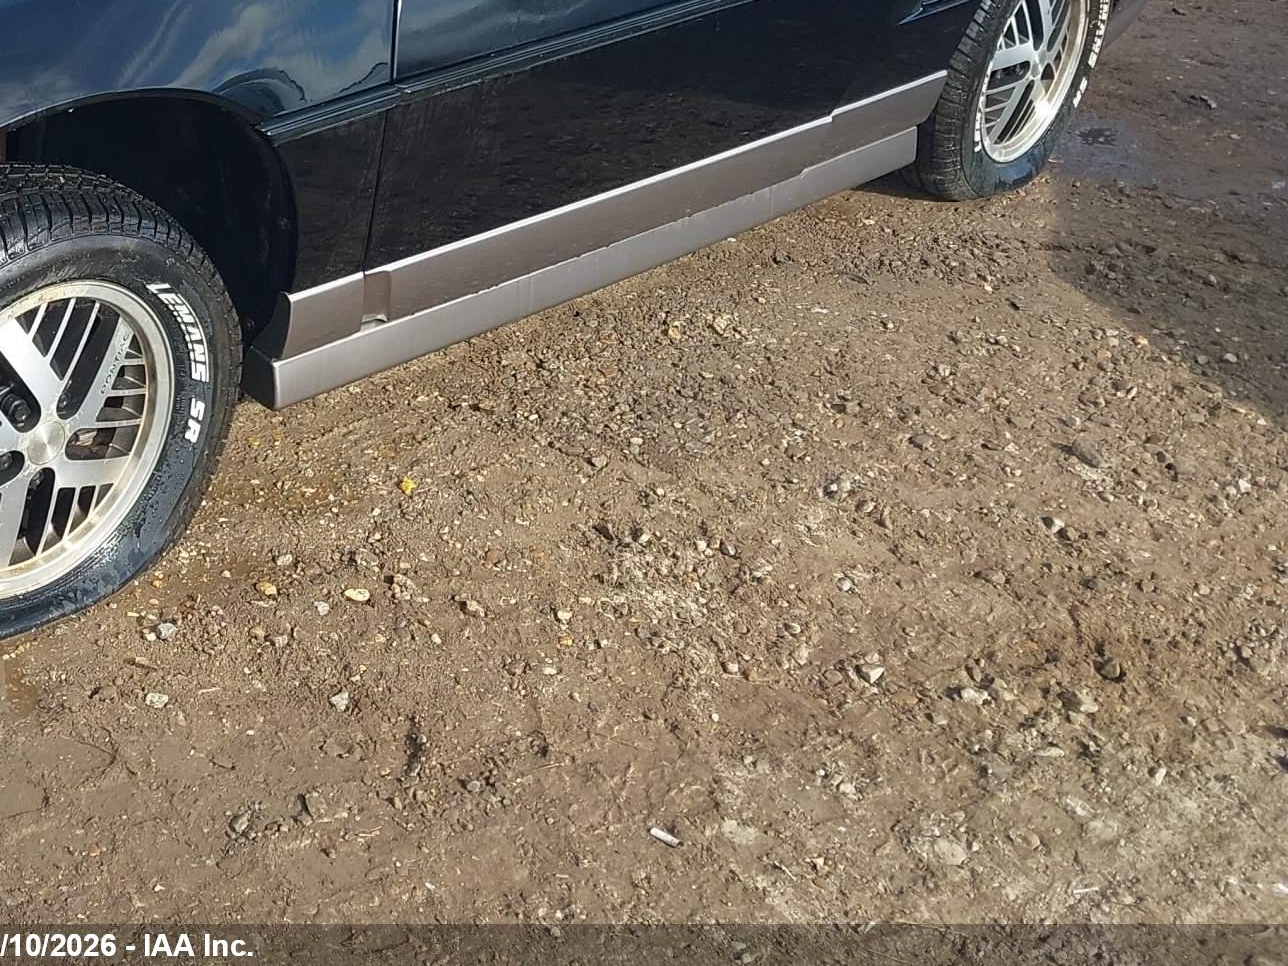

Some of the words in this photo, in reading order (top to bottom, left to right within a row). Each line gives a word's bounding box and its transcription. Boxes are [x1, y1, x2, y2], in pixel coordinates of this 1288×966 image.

[100, 332, 130, 394] PONTIAC
[145, 283, 209, 382] LEMANS
[184, 397, 206, 444] SR
